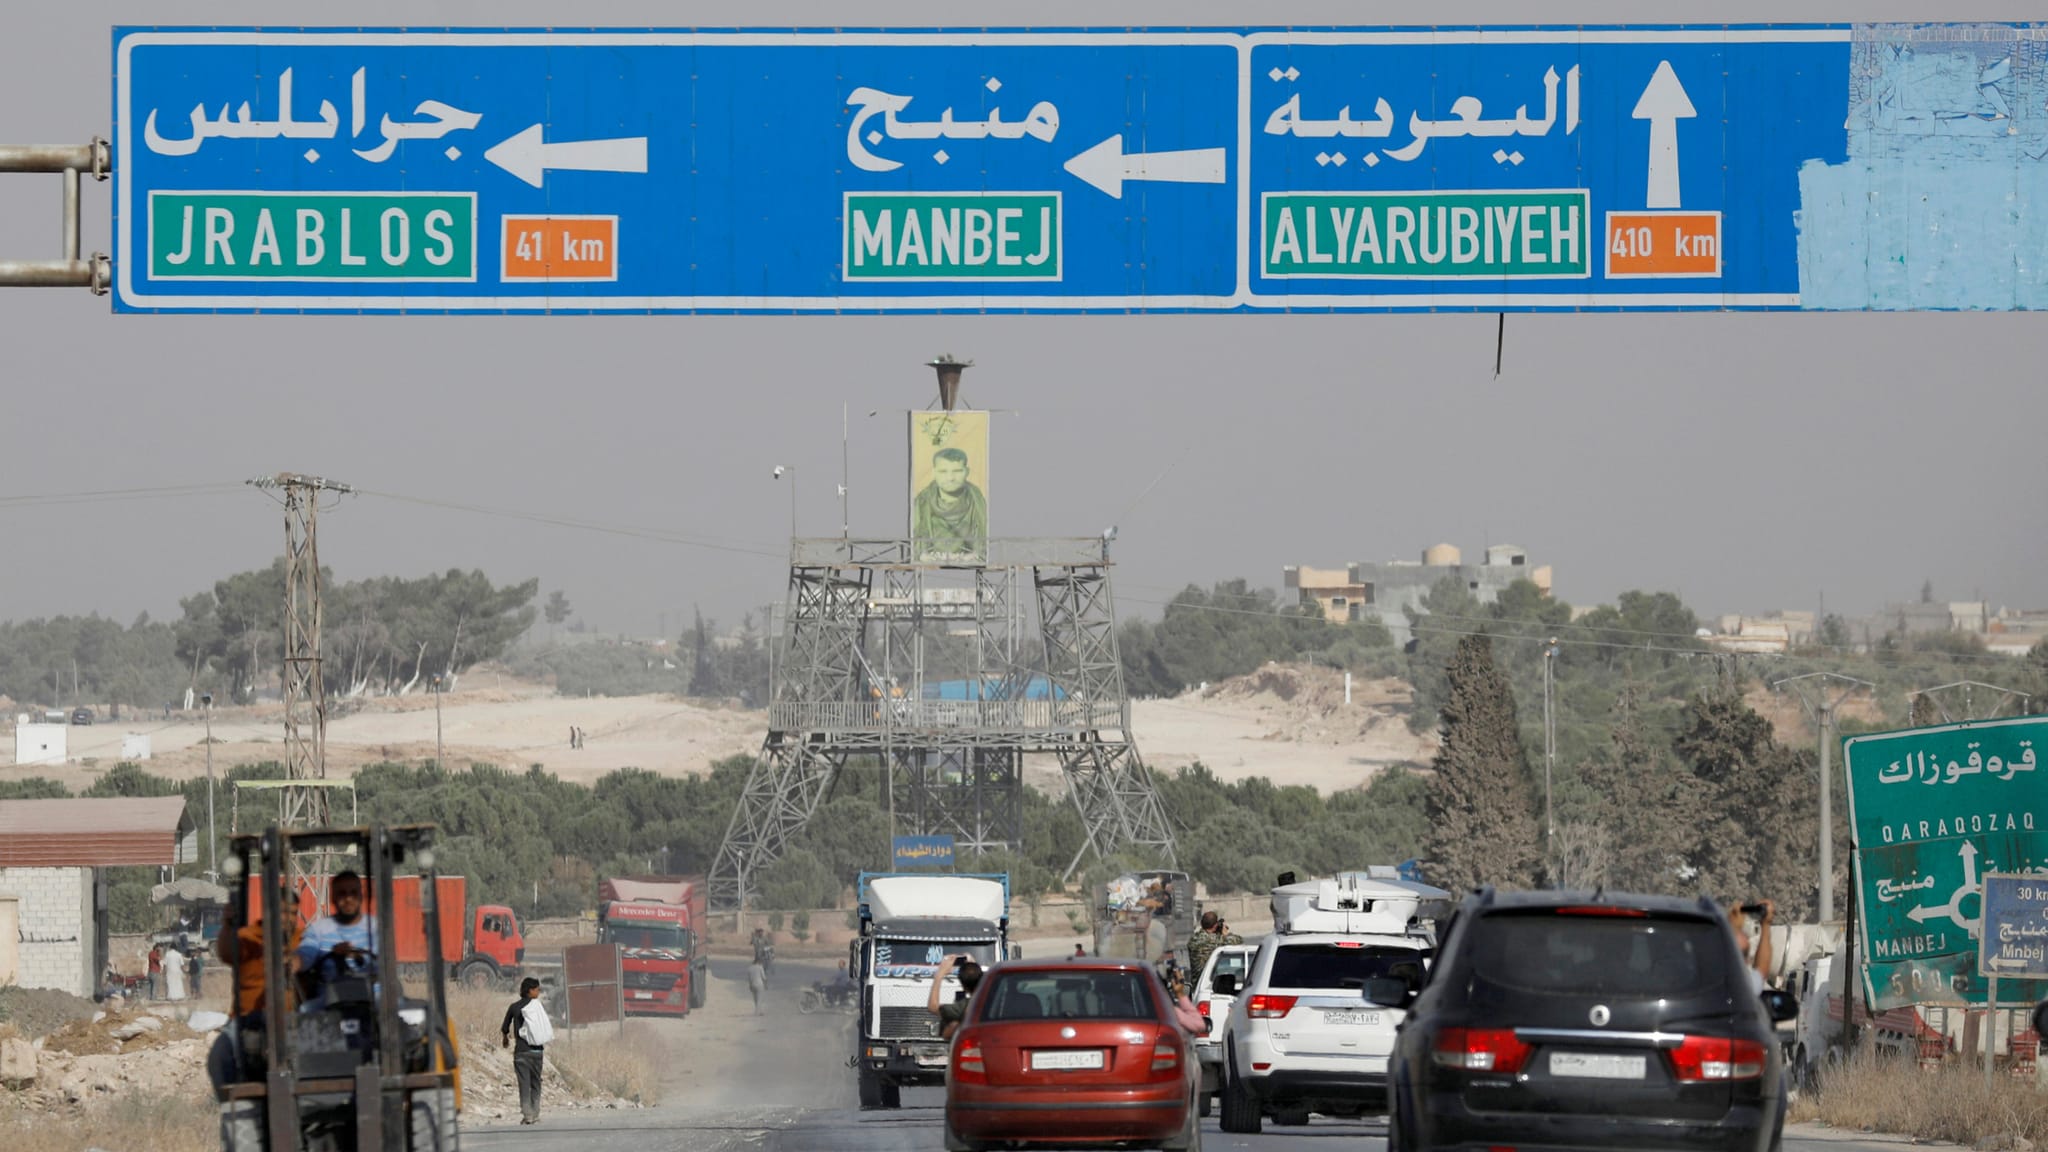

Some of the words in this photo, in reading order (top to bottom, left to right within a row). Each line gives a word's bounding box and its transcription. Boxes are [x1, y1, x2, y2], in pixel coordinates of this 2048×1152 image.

[144, 66, 484, 163] جرابلس
[846, 77, 1060, 172] منبج
[1264, 63, 1580, 167] اليعربية
[165, 204, 454, 266] JRABLOS
[515, 231, 543, 261] 41
[563, 230, 605, 261] km
[853, 206, 1051, 266] MANBEJ
[1269, 204, 1580, 264] ALYARUBIYEH
[1612, 227, 1652, 257] 410
[1674, 227, 1715, 257] km
[1879, 742, 1982, 785] قوزاك
[1986, 740, 2036, 780] قره
[1882, 812, 2034, 843] QARAQOZAQ
[1876, 870, 1935, 902] منبج
[2017, 887, 2032, 900] 30
[1875, 932, 1945, 957] MANBEJ
[2002, 943, 2045, 963] Mnbej
